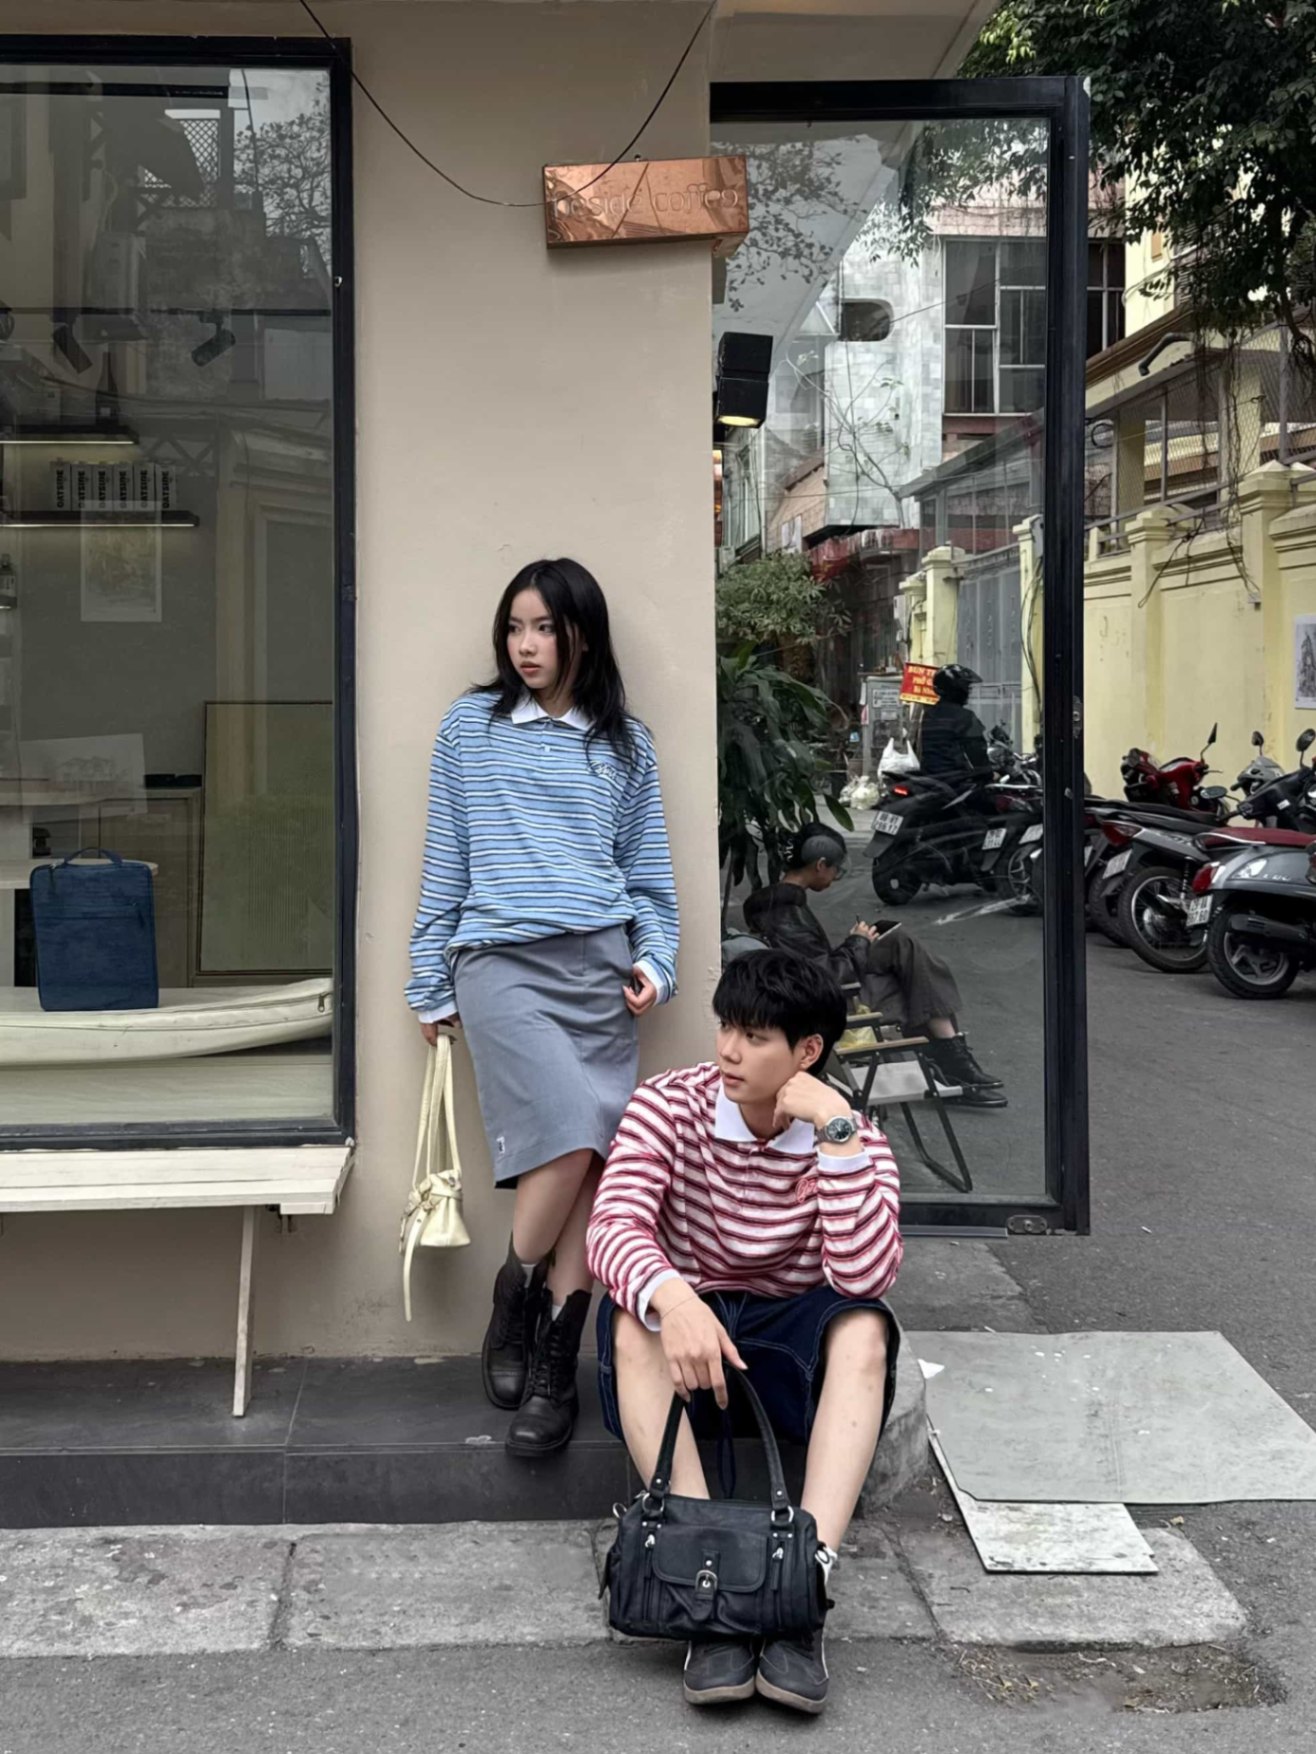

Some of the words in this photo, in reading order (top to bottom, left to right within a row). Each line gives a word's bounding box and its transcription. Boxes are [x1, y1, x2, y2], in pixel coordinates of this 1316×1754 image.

[653, 182, 739, 213] coffee
[56, 470, 64, 508] OATSIDE
[98, 470, 106, 508] OATSIDE
[119, 470, 127, 508] OATSIDE
[140, 469, 148, 508] OATSIDE
[162, 471, 170, 508] OATSIDE
